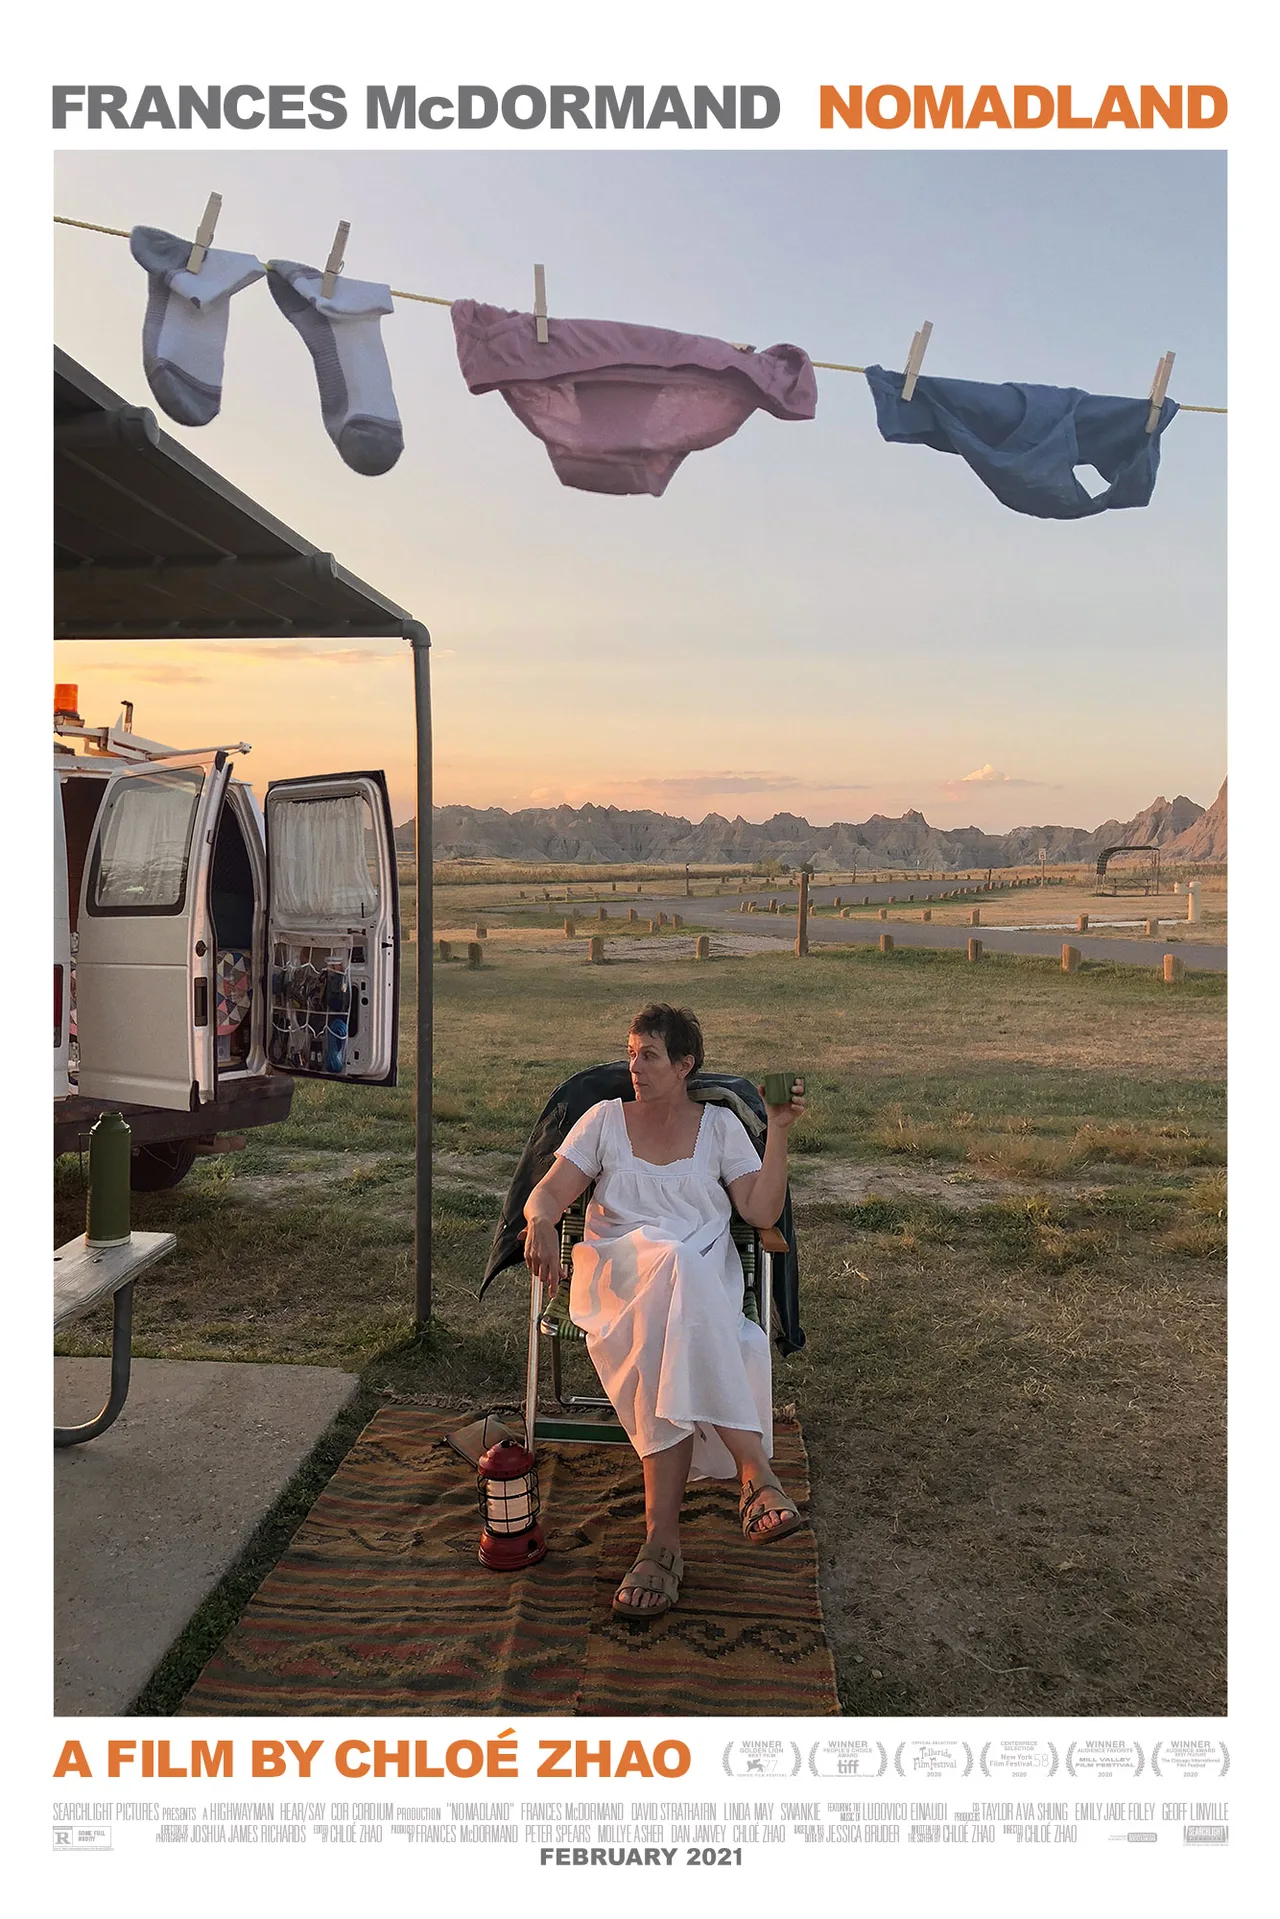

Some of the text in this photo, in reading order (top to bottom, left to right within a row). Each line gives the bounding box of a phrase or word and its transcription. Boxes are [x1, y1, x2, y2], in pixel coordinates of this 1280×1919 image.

[52, 85, 780, 129] FRANCES McDORMAND
[820, 85, 1227, 129] NOMADLAND
[53, 1727, 691, 1778] A FILM BY CHLOÉ ZHAO
[742, 1740, 782, 1748] WINNER
[828, 1740, 868, 1748] WINNER
[919, 1746, 952, 1759] Telluride
[1086, 1740, 1126, 1748] WINNER
[1170, 1740, 1211, 1748] WINNER
[837, 1760, 859, 1774] tiff
[1034, 1754, 1049, 1767] 58
[53, 1802, 820, 1822] SEARCHLIGHT PICTURES PRESENTS A HIGHWAYMAN HEAR/SAY COR CORDIUM PRODUCTION "NOMADLAND" FRANCES McDORMAND DAVID STRATHAIRN LINDA MAY SWANKIE
[862, 1803, 947, 1820] LUDOVICO EINAUDI
[981, 1803, 1229, 1820] TAYLOR AVA SHUNG EMILY JADE FOLEY GEOFF LINVILLE
[55, 1832, 71, 1845] R
[190, 1825, 306, 1842] JOSHUA JAMES RICHARDS
[330, 1822, 382, 1842] CHLOÉ ZHAO
[416, 1822, 786, 1842] FRANCES McDORMAND PETER SPEARS MOLLYE ASHER DAN JANVEY CHLOÉ ZHAO
[826, 1825, 900, 1842] JESSICA BRUDER
[943, 1822, 995, 1842] CHLOÉ ZHAO
[1025, 1822, 1077, 1842] CHLOÉ ZHAO
[540, 1848, 742, 1866] FEBRUARY 2021
